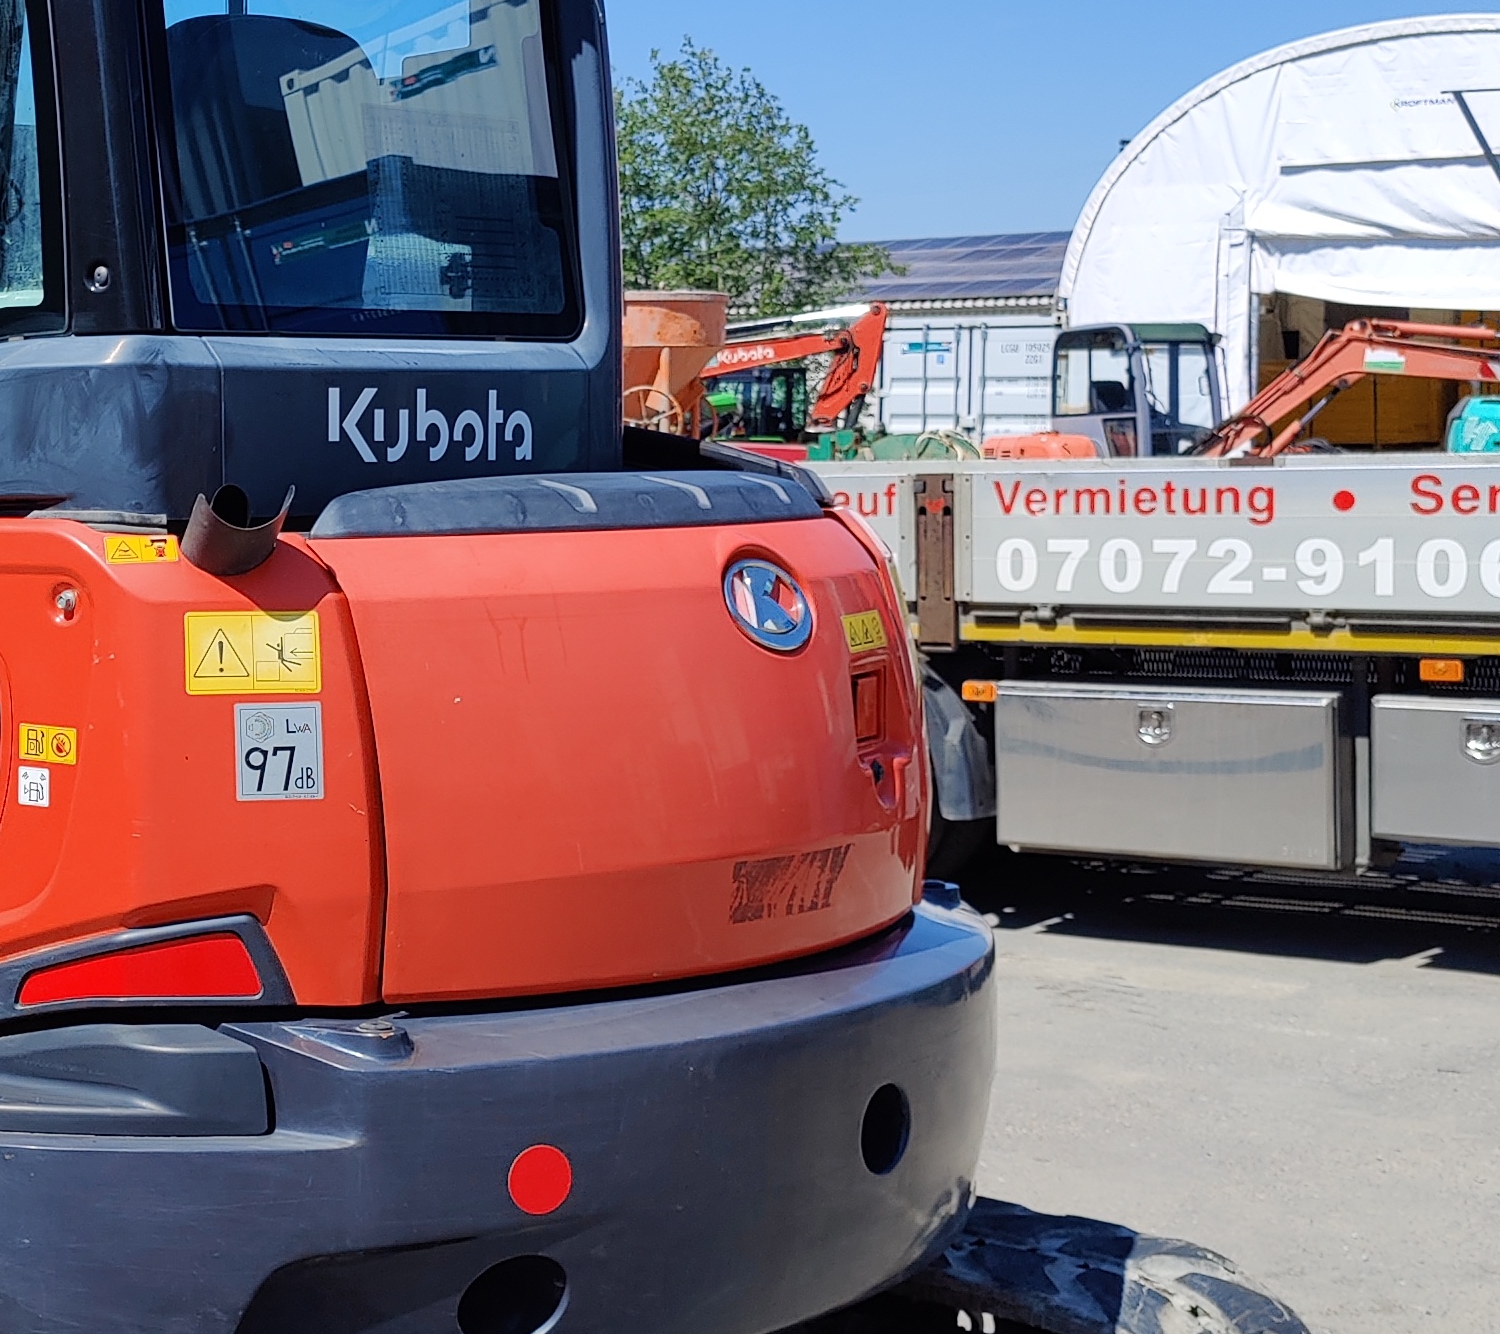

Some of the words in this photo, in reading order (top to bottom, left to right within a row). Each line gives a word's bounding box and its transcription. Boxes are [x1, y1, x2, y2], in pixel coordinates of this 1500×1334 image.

[717, 346, 775, 364] Kubota
[328, 387, 532, 463] Kubota
[993, 478, 1275, 526] Vermietung
[244, 745, 296, 792] 97
[294, 766, 316, 789] dB
